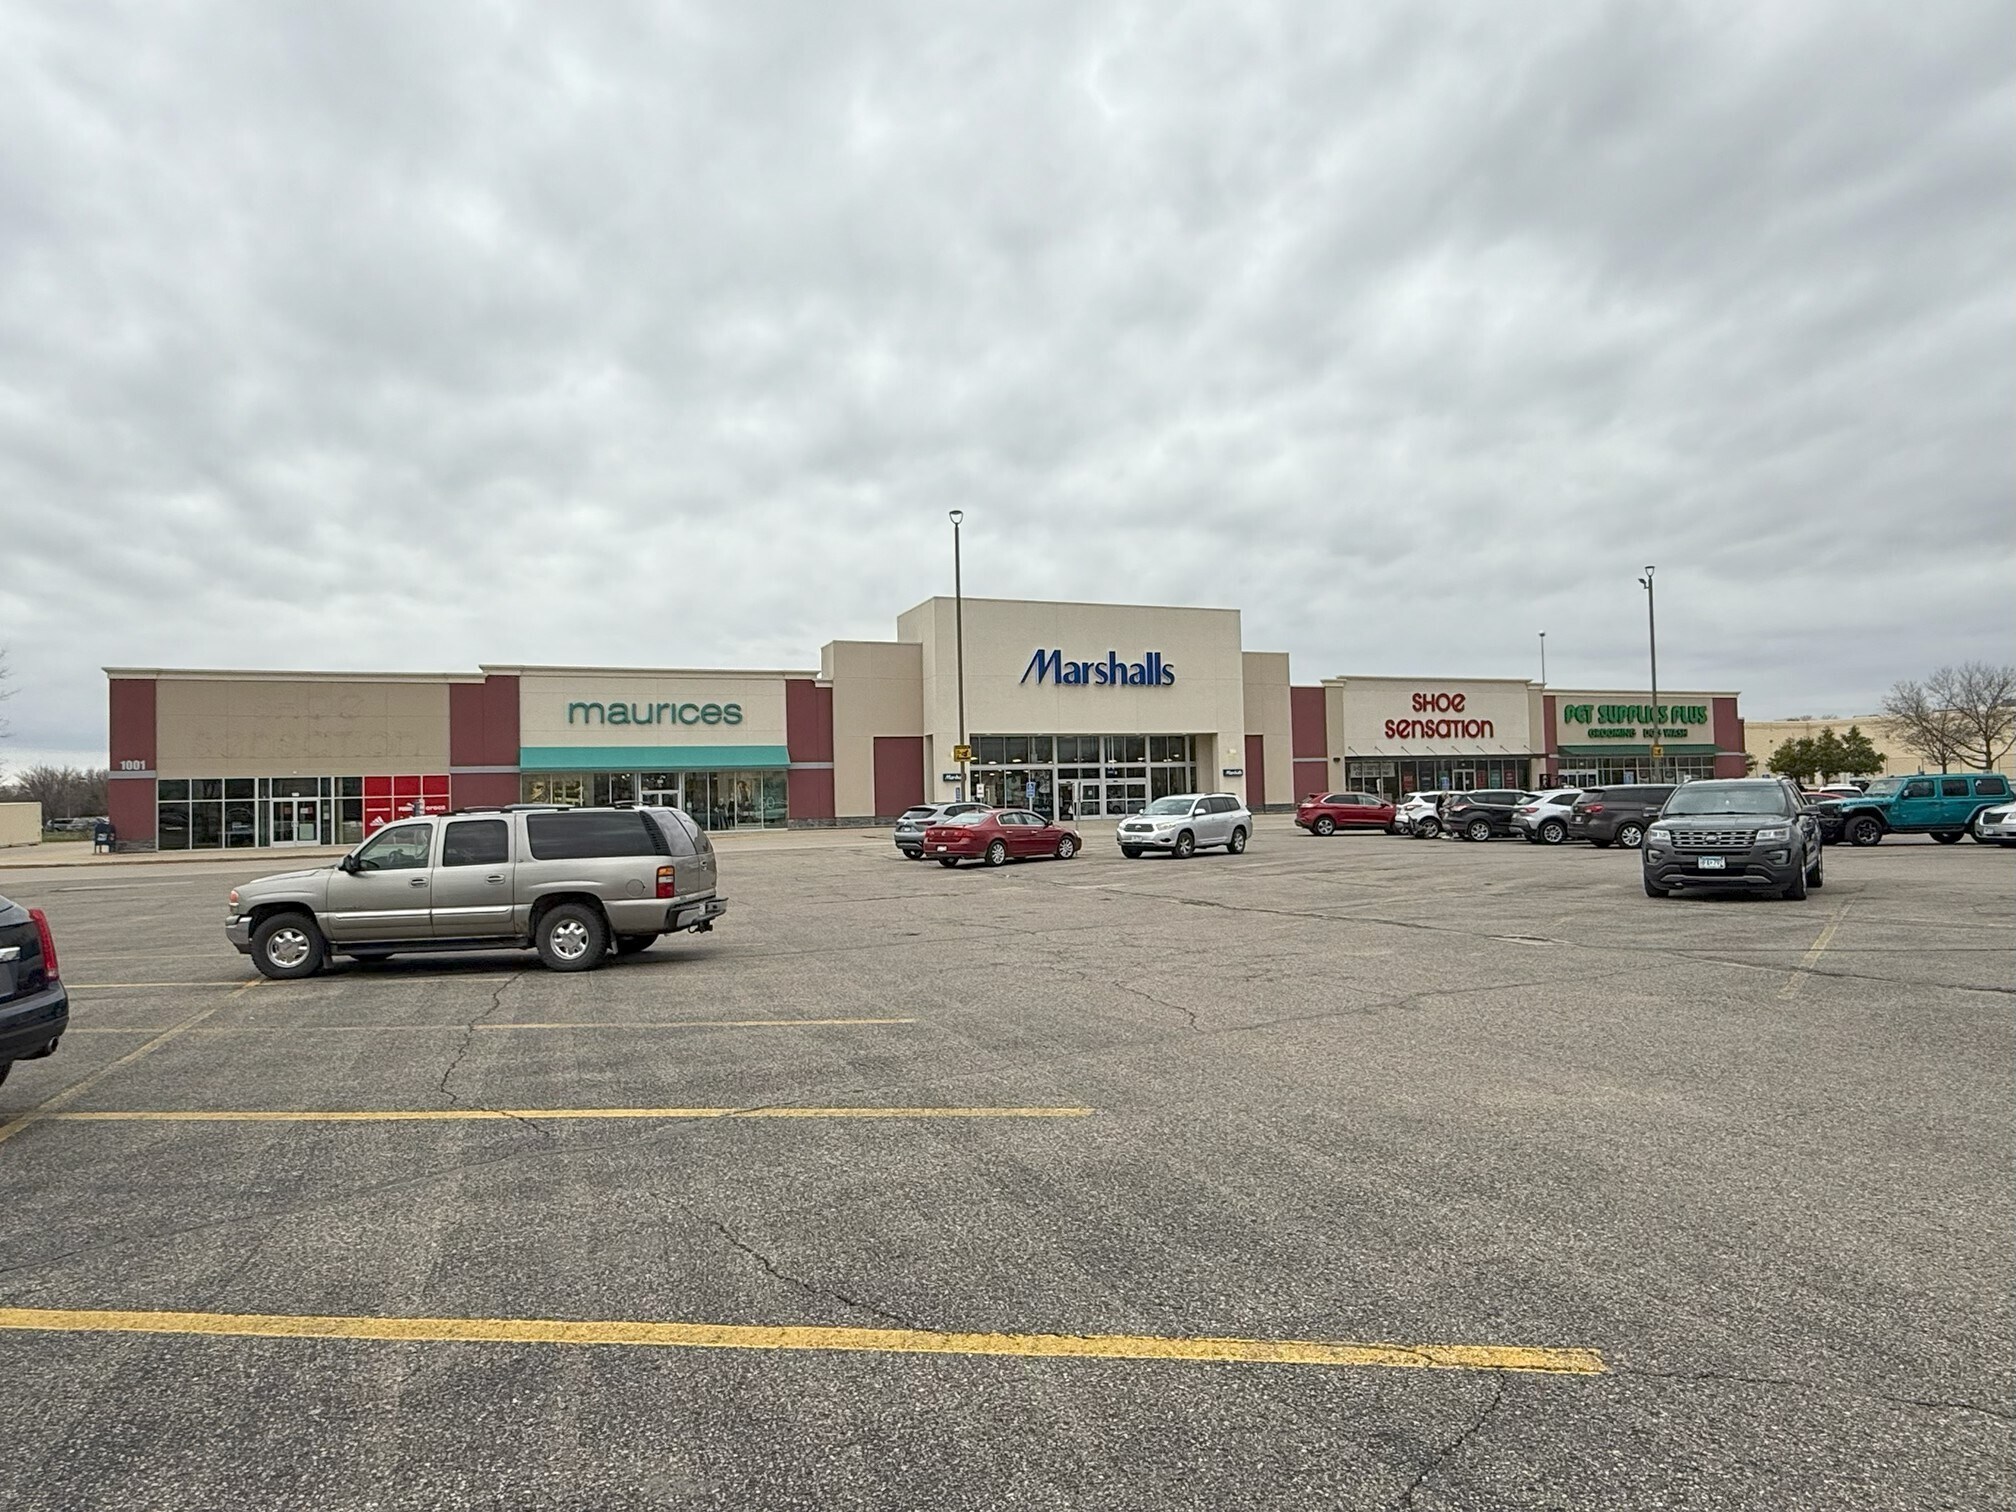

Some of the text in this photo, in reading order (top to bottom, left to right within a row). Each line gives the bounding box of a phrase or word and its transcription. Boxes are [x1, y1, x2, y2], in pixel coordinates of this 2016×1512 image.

[1020, 649, 1175, 686] Marshalls
[569, 702, 743, 725] maurices
[1564, 705, 1594, 724] PET
[1671, 706, 1707, 724] PLUS
[1588, 728, 1636, 738] GROOMING
[1663, 729, 1688, 738] WASH
[120, 760, 146, 770] 1001
